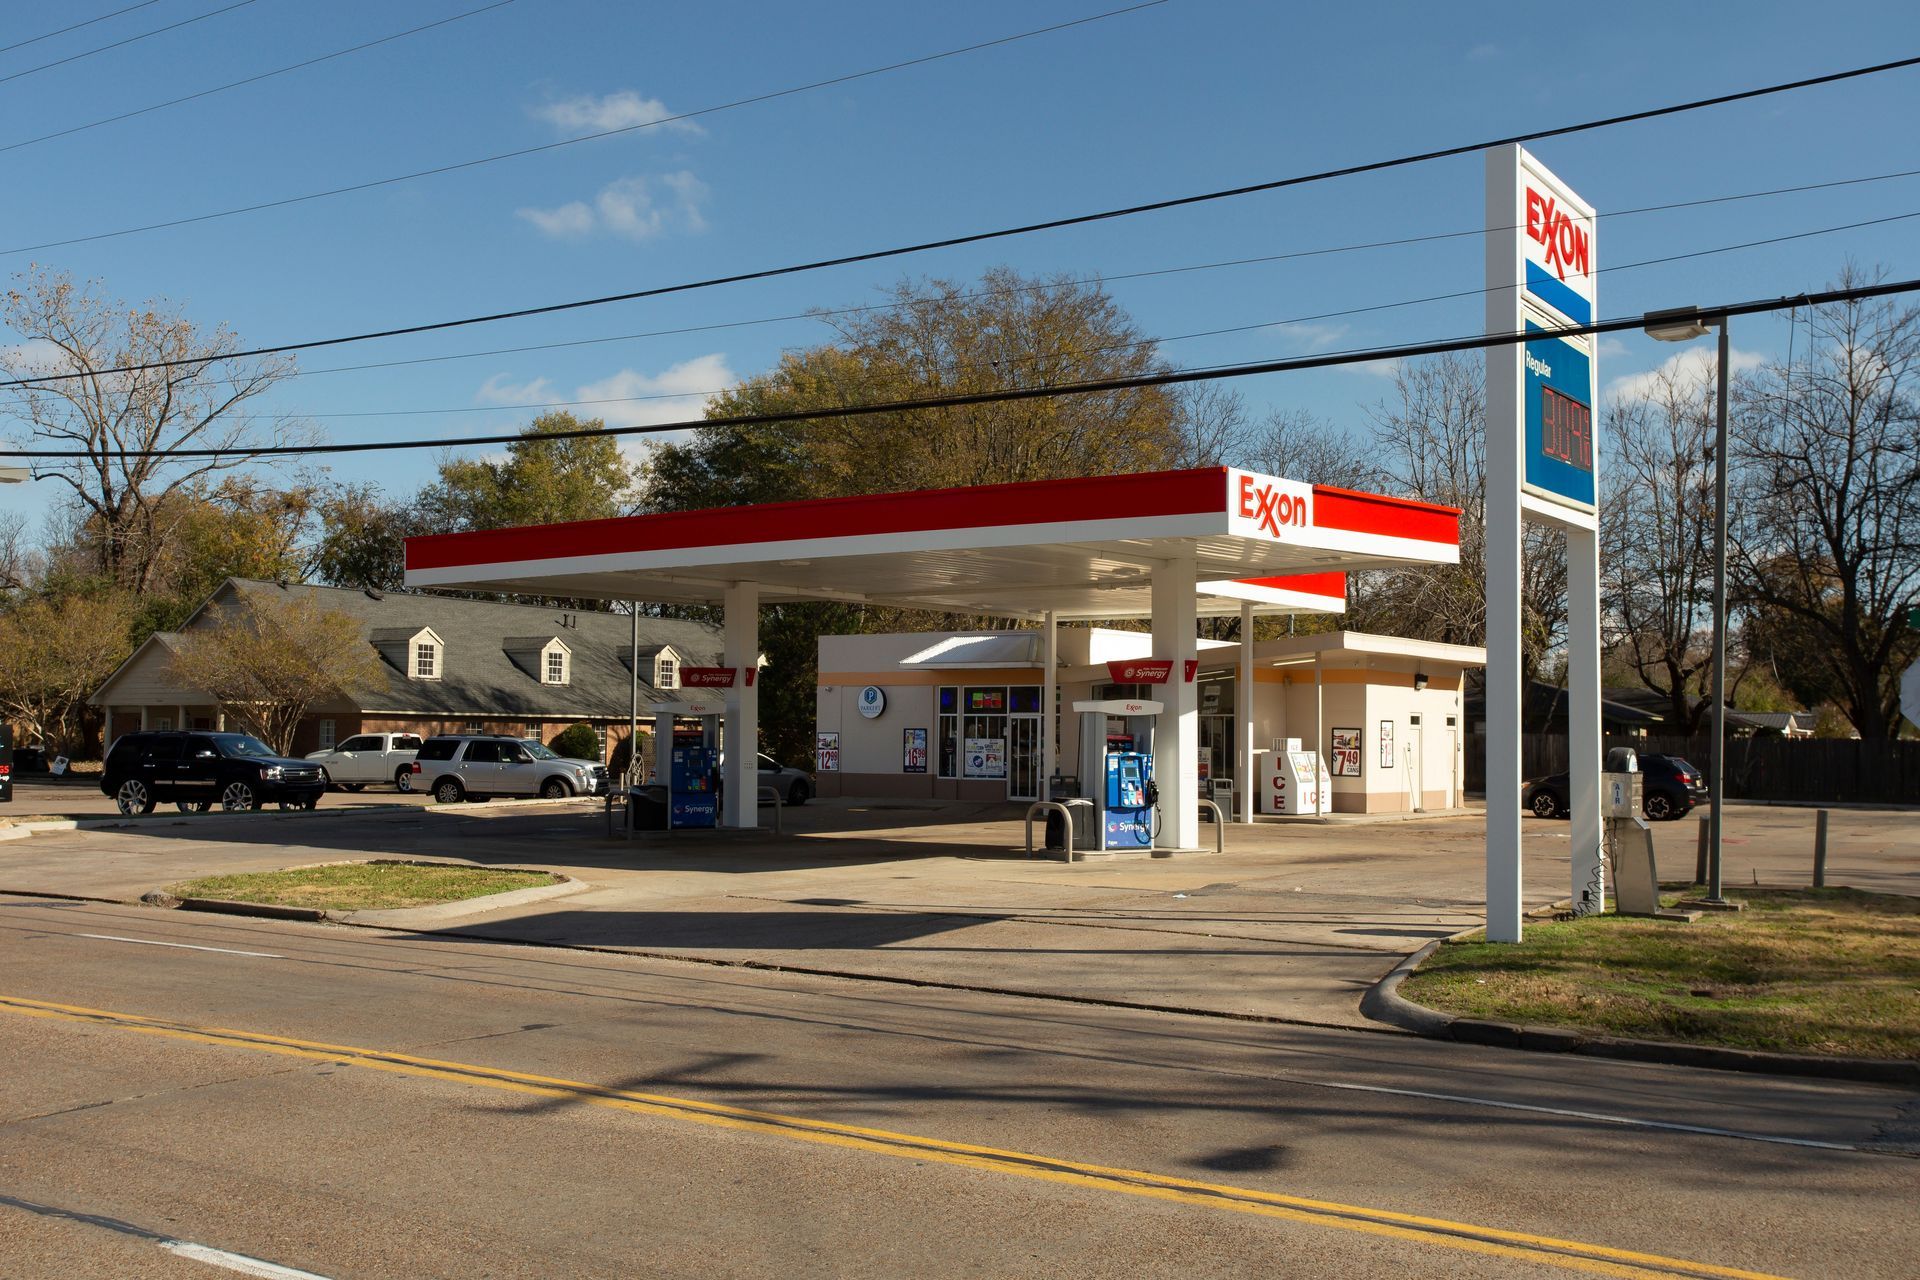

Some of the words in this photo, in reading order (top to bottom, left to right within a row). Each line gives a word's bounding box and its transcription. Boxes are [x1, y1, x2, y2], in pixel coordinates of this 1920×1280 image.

[1526, 186, 1589, 283] EXXON
[1526, 350, 1552, 378] Regular
[1238, 475, 1306, 538] Exxon
[701, 674, 731, 684] Synergy
[1136, 669, 1167, 679] Synergy
[1126, 704, 1143, 712] Exxon
[1273, 757, 1285, 810] ICE
[684, 805, 714, 815] Synergy
[1119, 822, 1150, 833] Synergy
